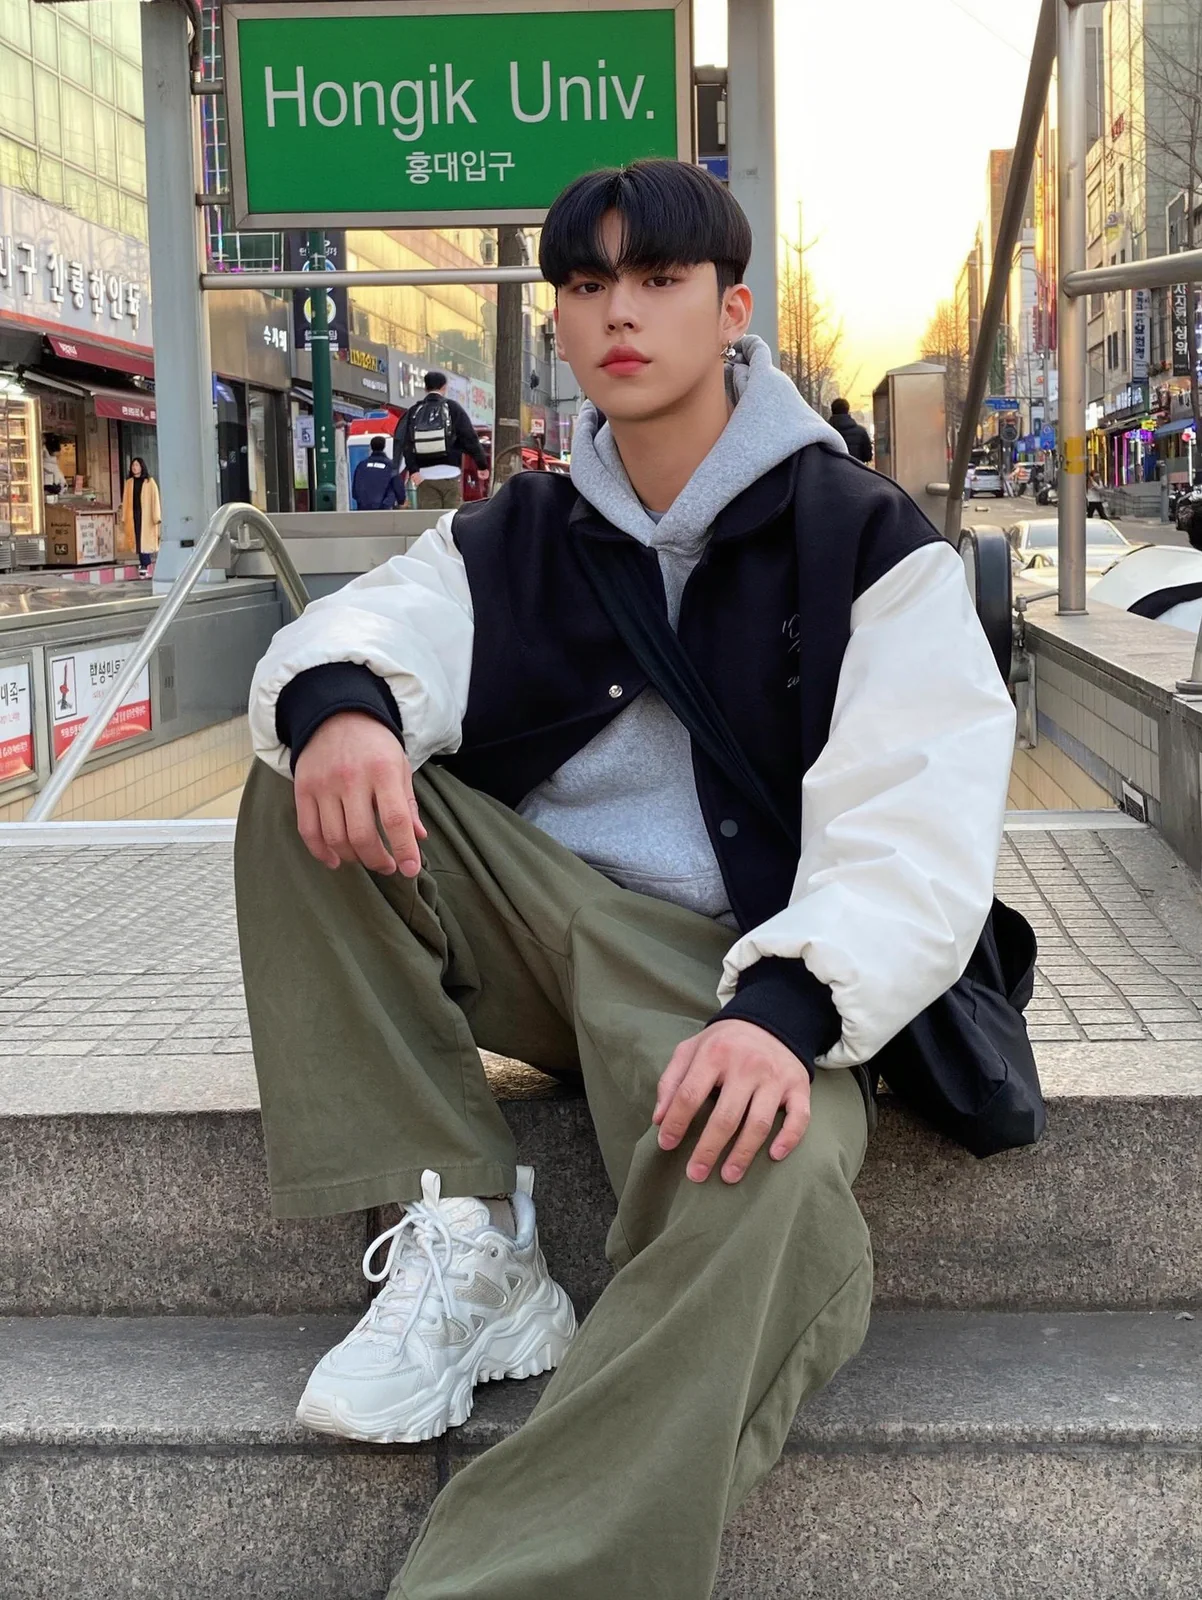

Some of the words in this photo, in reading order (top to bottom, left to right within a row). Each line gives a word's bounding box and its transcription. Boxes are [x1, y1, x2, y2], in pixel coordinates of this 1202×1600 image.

[264, 63, 478, 142] Hongik
[509, 59, 655, 123] Univ.
[405, 150, 515, 185] 홍대입구
